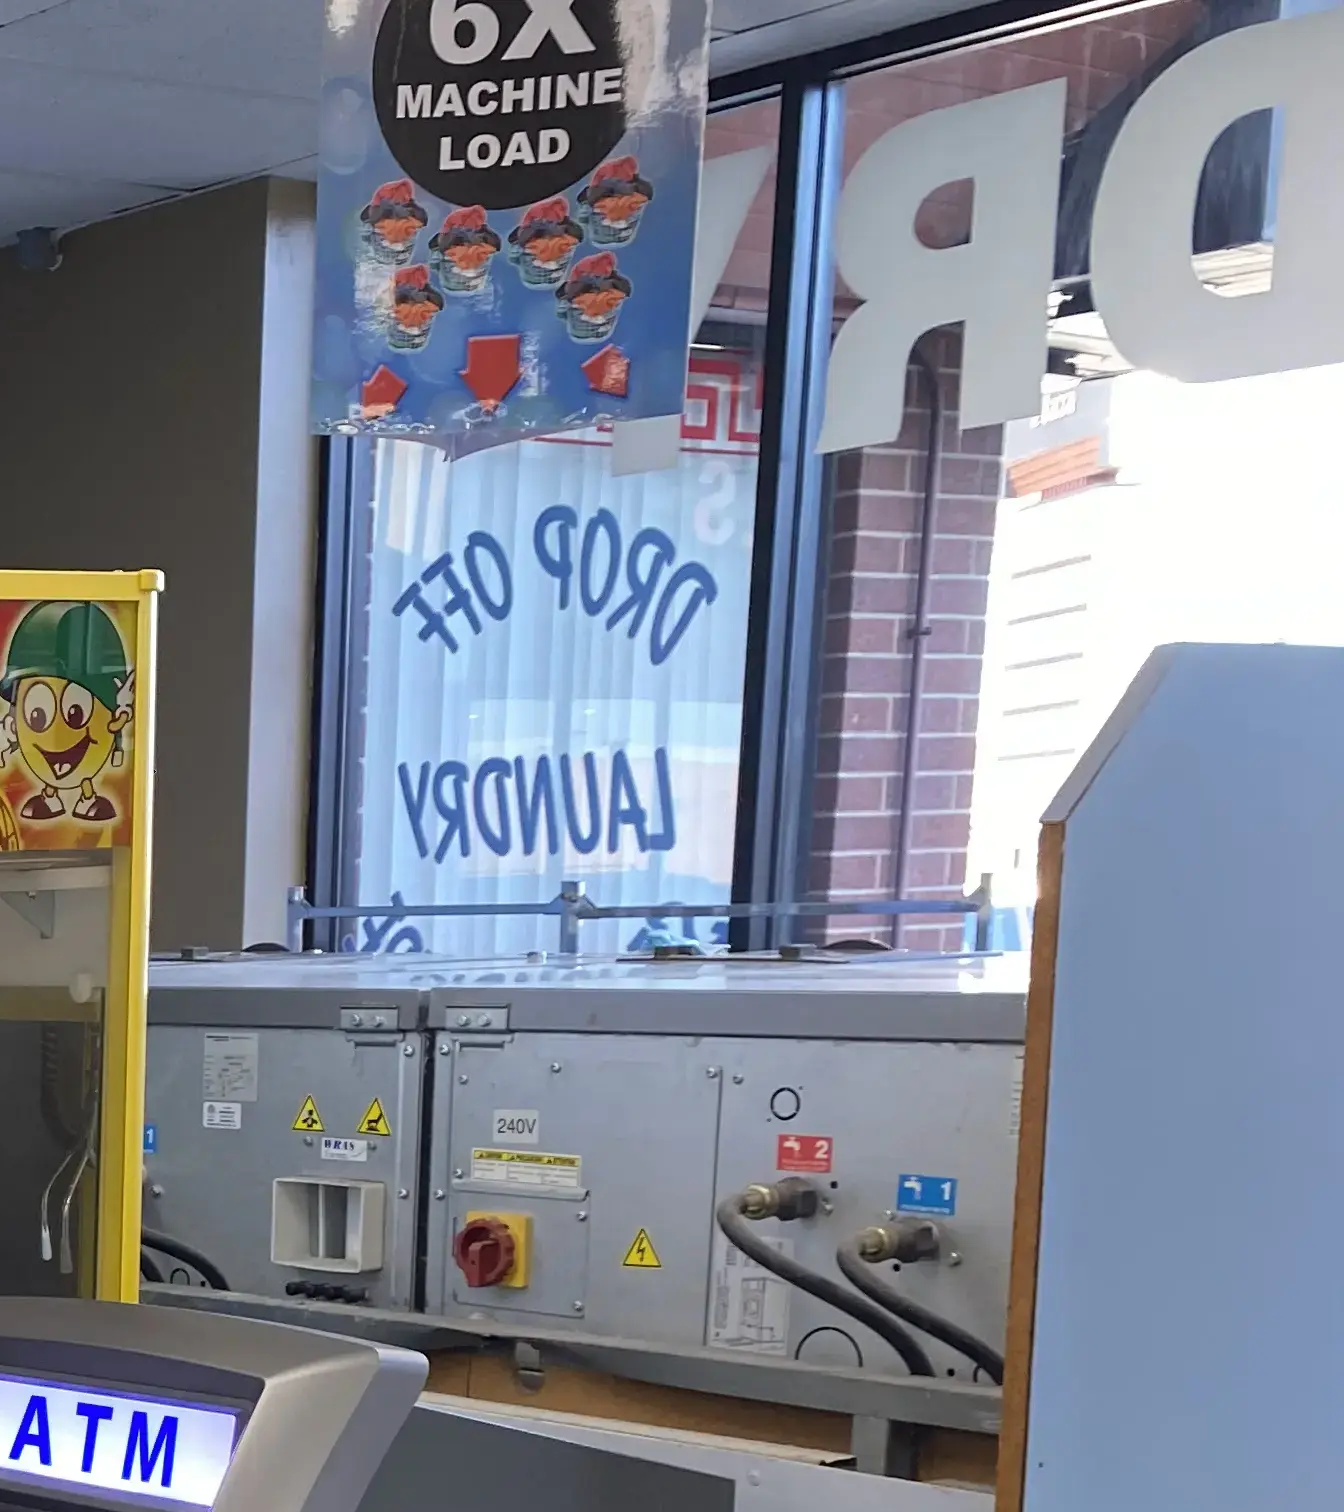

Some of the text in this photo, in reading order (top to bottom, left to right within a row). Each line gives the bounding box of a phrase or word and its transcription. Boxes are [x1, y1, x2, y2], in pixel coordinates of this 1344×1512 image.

[429, 0, 596, 65] 6X
[396, 68, 624, 119] MACHINE
[439, 128, 571, 170] LOAD
[497, 1118, 537, 1134] 240V
[814, 1140, 829, 1159] 2
[940, 1181, 952, 1201] 1
[8, 1394, 179, 1489] ATM
